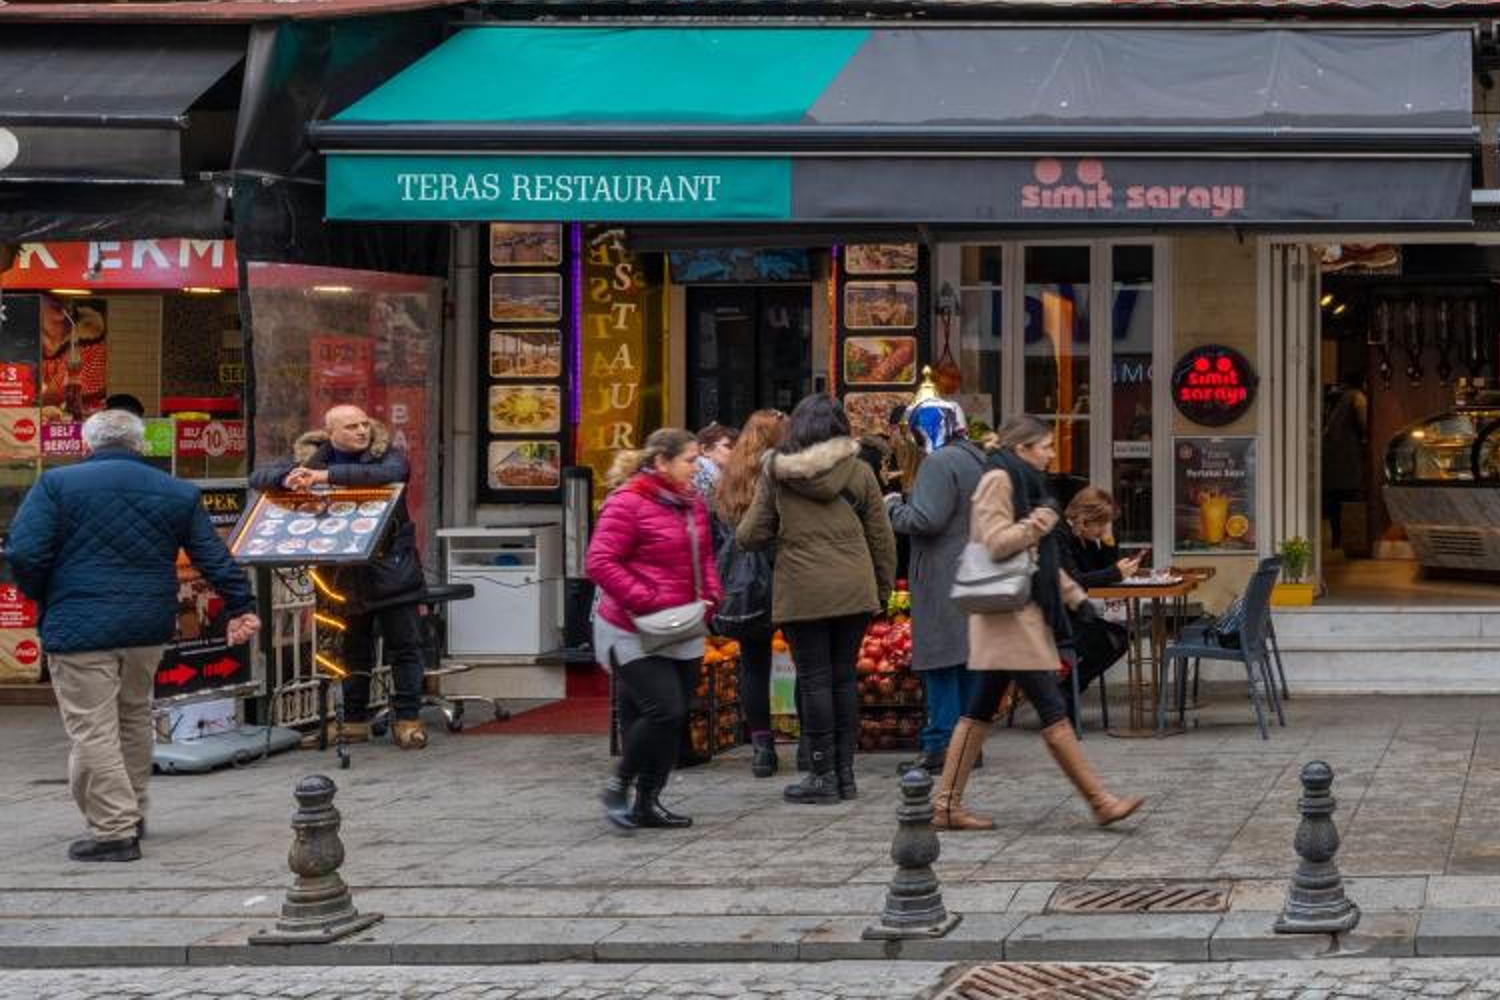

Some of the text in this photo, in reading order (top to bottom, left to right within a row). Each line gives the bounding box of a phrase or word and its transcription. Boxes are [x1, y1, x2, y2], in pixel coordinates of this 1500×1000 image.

[397, 173, 721, 202] TERAS RESTAURANT
[1021, 158, 1113, 209] simit
